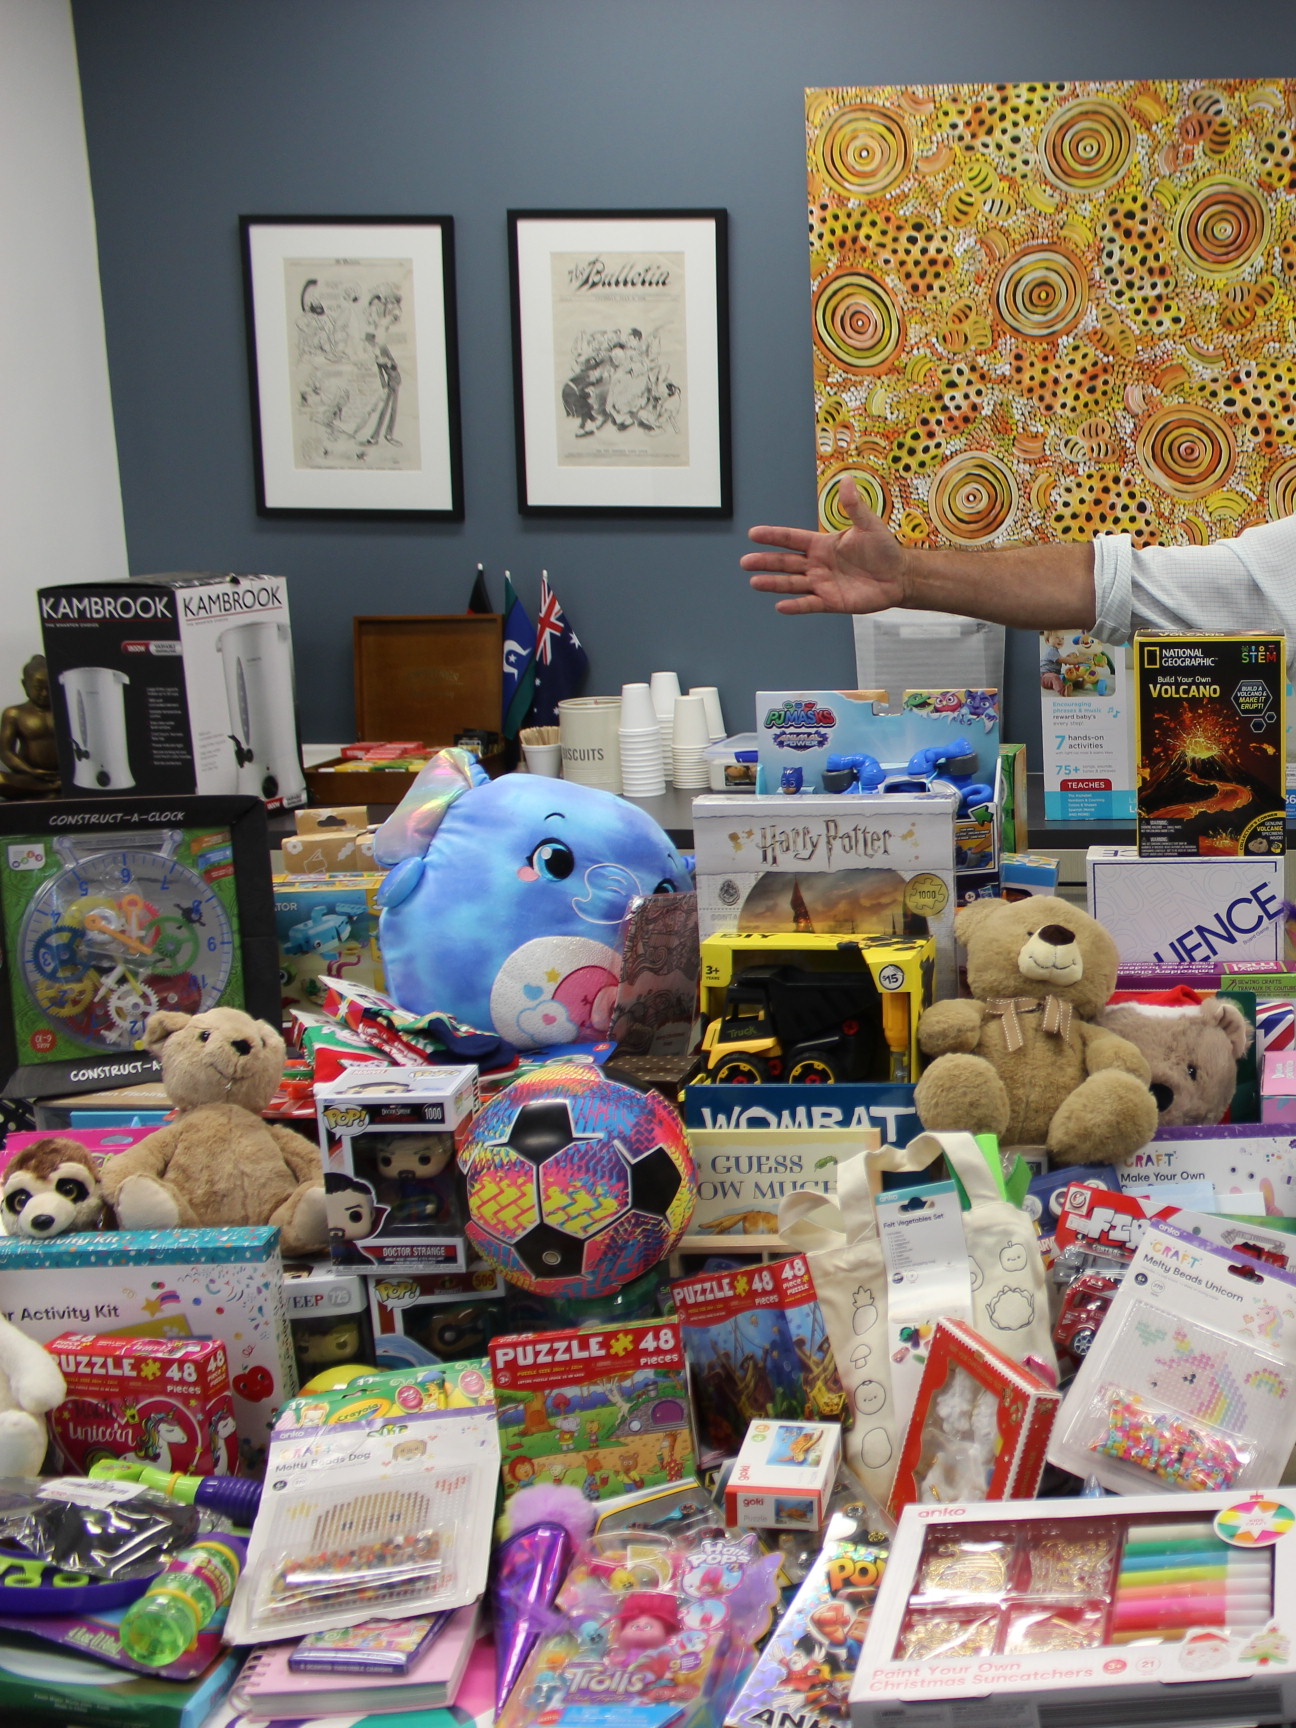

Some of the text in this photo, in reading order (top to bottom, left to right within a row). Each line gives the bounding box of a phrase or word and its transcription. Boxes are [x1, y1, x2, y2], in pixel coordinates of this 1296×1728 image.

[577, 255, 671, 291] Bulletin
[41, 596, 173, 619] KAMBROOK
[183, 586, 283, 618] KAMBROOK
[1162, 648, 1204, 658] NATIONAL
[1162, 657, 1215, 667] GEOGRAPHIC
[1241, 651, 1277, 663] STEM
[1149, 684, 1221, 698] VOLCANO
[1054, 735, 1066, 750] 7
[1055, 764, 1080, 775] 75+
[1067, 781, 1105, 789] TEACHES
[49, 811, 186, 827] CONSTRUCT-A-CLOCK
[757, 818, 892, 869] Harry Potter
[917, 889, 937, 900] 1000
[1154, 881, 1285, 962] UENCE
[1241, 926, 1270, 946] Board Game
[705, 965, 720, 976] 3+
[881, 973, 899, 986] $15
[726, 1025, 758, 1038] Truck
[324, 1108, 369, 1130] POP!
[424, 1107, 442, 1120] 1000
[700, 1105, 916, 1143] WOMBAT
[710, 1154, 804, 1175] GUESS
[1120, 1170, 1206, 1183] Make Your Own
[883, 1221, 896, 1229] Felt
[897, 1215, 932, 1227] Vegetables
[1158, 1223, 1181, 1237] anko
[383, 1246, 446, 1257] DOCTOR STRANGE
[1151, 1241, 1202, 1269] CRAFT
[781, 1258, 806, 1281] 48
[1143, 1253, 1244, 1303] Melty Beads Unicorn
[474, 1274, 495, 1289] 509
[751, 1271, 774, 1293] 48
[329, 1289, 349, 1305] 725
[376, 1283, 419, 1304] POP!
[672, 1277, 734, 1307] PUZZLE
[20, 1304, 120, 1323] Activity Kit
[638, 1328, 676, 1353] 48
[206, 1350, 226, 1373] 48
[494, 1337, 606, 1369] PUZZLE
[165, 1362, 198, 1382] 48
[336, 1403, 379, 1422] Crayola
[68, 1414, 137, 1447] Unicorn
[279, 1431, 305, 1439] anko
[275, 1451, 371, 1472] Melty Dog
[742, 1496, 764, 1508] goki
[743, 1514, 768, 1523] Puzzle
[917, 1507, 967, 1519] anko
[872, 1659, 1021, 1680] Paint Your Own
[1140, 1660, 1155, 1670] 21
[566, 1667, 646, 1695] Trolls
[869, 1666, 1094, 1693] Christmas Suncatchers
